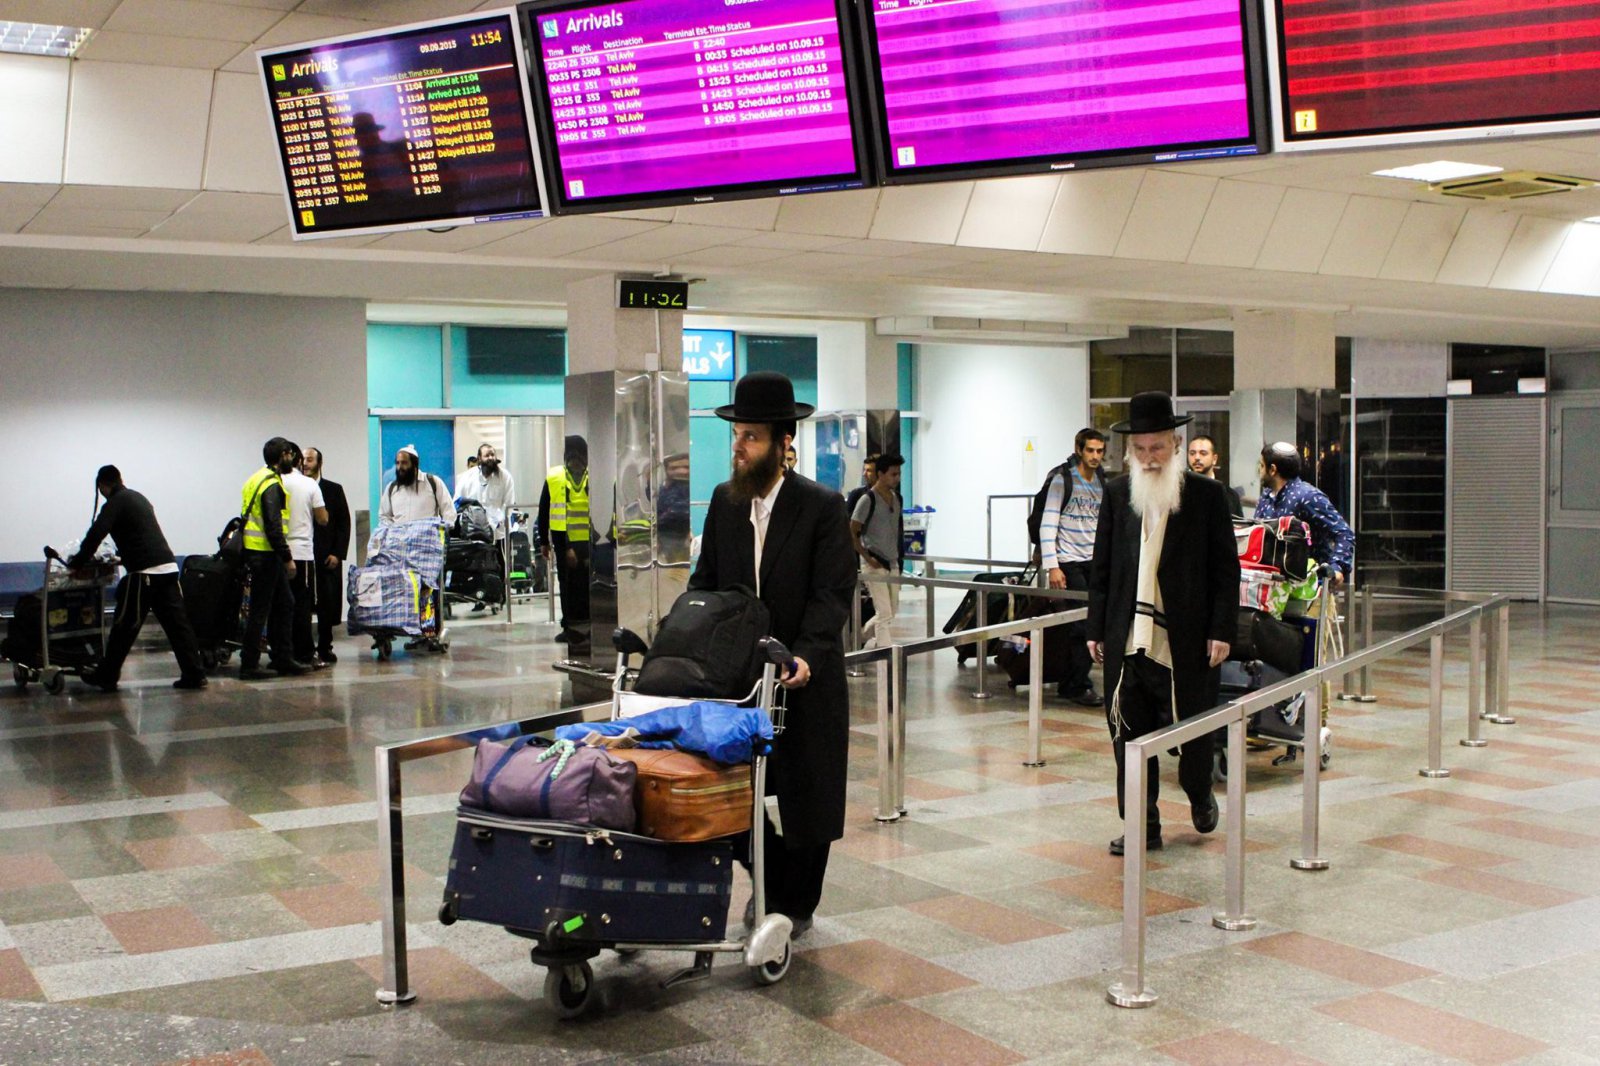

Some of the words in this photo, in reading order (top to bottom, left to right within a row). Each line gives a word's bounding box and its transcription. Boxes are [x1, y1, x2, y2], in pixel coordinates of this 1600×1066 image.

[566, 9, 624, 34] Arrivals
[420, 40, 457, 53] 09.09.2015
[471, 30, 502, 46] 11:54
[547, 48, 564, 56] Time
[571, 43, 592, 54] Flight
[603, 36, 643, 48] Destination
[664, 28, 695, 39] Terminal
[696, 27, 708, 35] Est.
[709, 24, 727, 33] Time
[727, 21, 751, 31] Status
[605, 53, 618, 61] Tel
[618, 50, 635, 60] Aviv
[607, 65, 619, 74] Tel
[620, 63, 637, 72] Aviv
[731, 44, 775, 57] Scheduled
[789, 38, 824, 50] 10.09.15
[292, 56, 338, 78] Arrivals
[423, 67, 443, 76] Status
[609, 77, 621, 86] Tel
[622, 75, 639, 84] Aviv
[733, 57, 777, 70] Scheduled
[791, 51, 826, 63] 10.09.15
[405, 82, 423, 91] 11:04
[426, 78, 450, 88] Arrived
[460, 74, 479, 83] 11:04
[611, 90, 623, 98] Tel
[624, 87, 640, 97] Aviv
[734, 70, 778, 83] Scheduled
[793, 64, 827, 76] 10.09.15
[428, 90, 452, 100] Arrived
[462, 86, 481, 95] 11:14
[613, 102, 625, 110] Tel
[626, 100, 642, 109] Aviv
[736, 83, 780, 95] Scheduled
[794, 77, 829, 89] 10.09.15
[430, 101, 458, 113] Delayed
[469, 97, 488, 106] 17:20
[578, 119, 588, 127] PS
[615, 114, 627, 123] Tel
[628, 112, 644, 121] Aviv
[738, 96, 782, 108] Scheduled
[796, 90, 831, 101] 10.09.15
[432, 113, 460, 125] Delayed
[617, 126, 629, 135] Tel
[630, 124, 646, 133] Aviv
[740, 109, 783, 121] Scheduled
[798, 103, 832, 114] 10.09.15
[434, 124, 462, 136] Delayed
[436, 136, 464, 148] Delayed
[475, 132, 494, 141] 14:09
[438, 147, 466, 159] Delayed
[477, 144, 496, 152] 14:27
[419, 163, 437, 171] 19:00
